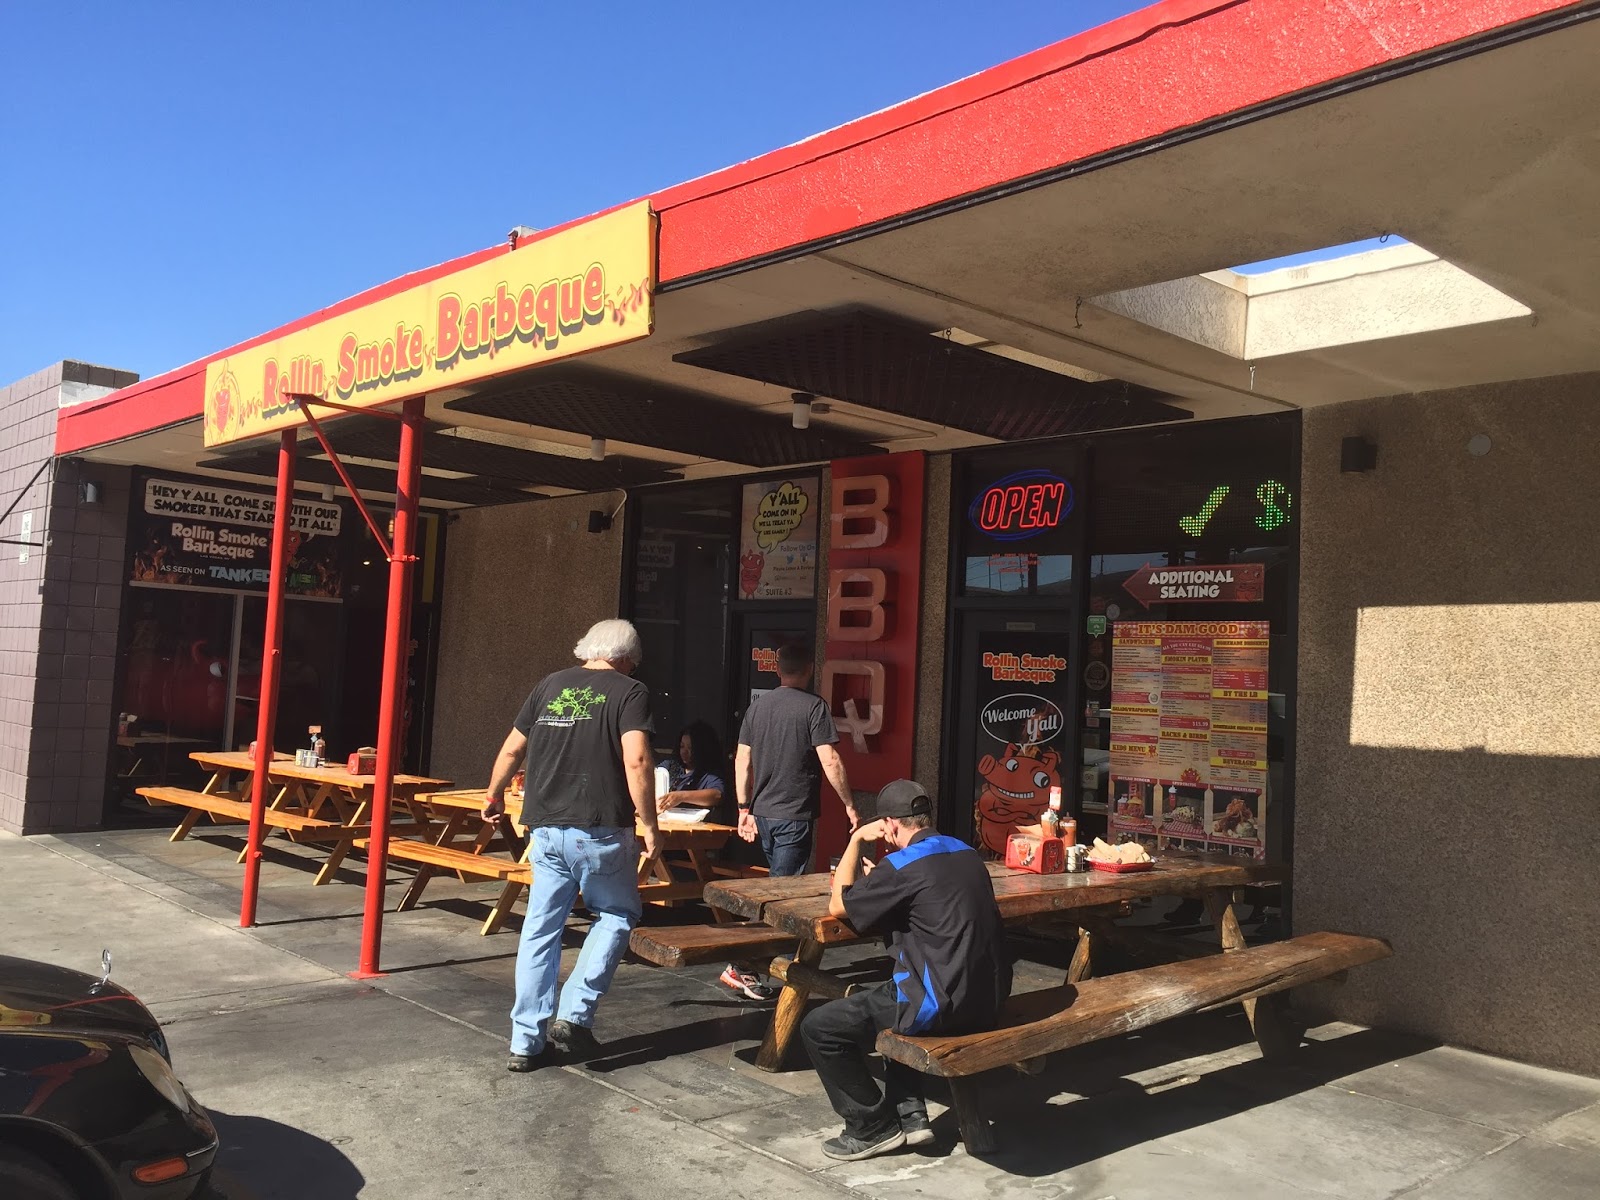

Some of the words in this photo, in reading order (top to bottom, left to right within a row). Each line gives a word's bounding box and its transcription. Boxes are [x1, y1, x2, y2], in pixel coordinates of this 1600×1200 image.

[262, 355, 325, 417] Rollin
[336, 321, 423, 399] Smoke
[435, 262, 606, 367] Barbeque
[223, 494, 260, 509] COME
[262, 500, 276, 511] SI
[291, 503, 312, 516] ITH
[314, 507, 338, 520] OUR
[770, 492, 800, 506] Y'ALL
[980, 483, 1065, 530] OPEN
[154, 499, 207, 515] SMOKER
[209, 506, 241, 520] THAT
[298, 518, 309, 528] IT
[763, 510, 779, 519] COME
[780, 509, 790, 517] ON
[790, 508, 798, 516] IN
[171, 522, 215, 541] Rollin
[218, 528, 268, 548] Smoke
[183, 537, 256, 560] Barbeque
[172, 565, 193, 575] SEEN
[194, 567, 206, 575] ON
[1148, 569, 1234, 585] ADDITIONAL
[766, 588, 783, 596] SUITE
[1160, 584, 1220, 599] SEATING
[821, 474, 890, 754] BBQ
[1137, 623, 1164, 634] IT'S
[1165, 622, 1196, 634] DAM
[1198, 623, 1240, 635] GOOD
[752, 648, 775, 660] Rollin
[983, 652, 1020, 668] Rollin
[1021, 653, 1066, 670] Smoke
[992, 667, 1055, 684] Barbeque
[1234, 690, 1247, 698] THE
[984, 707, 1036, 723] Welcome
